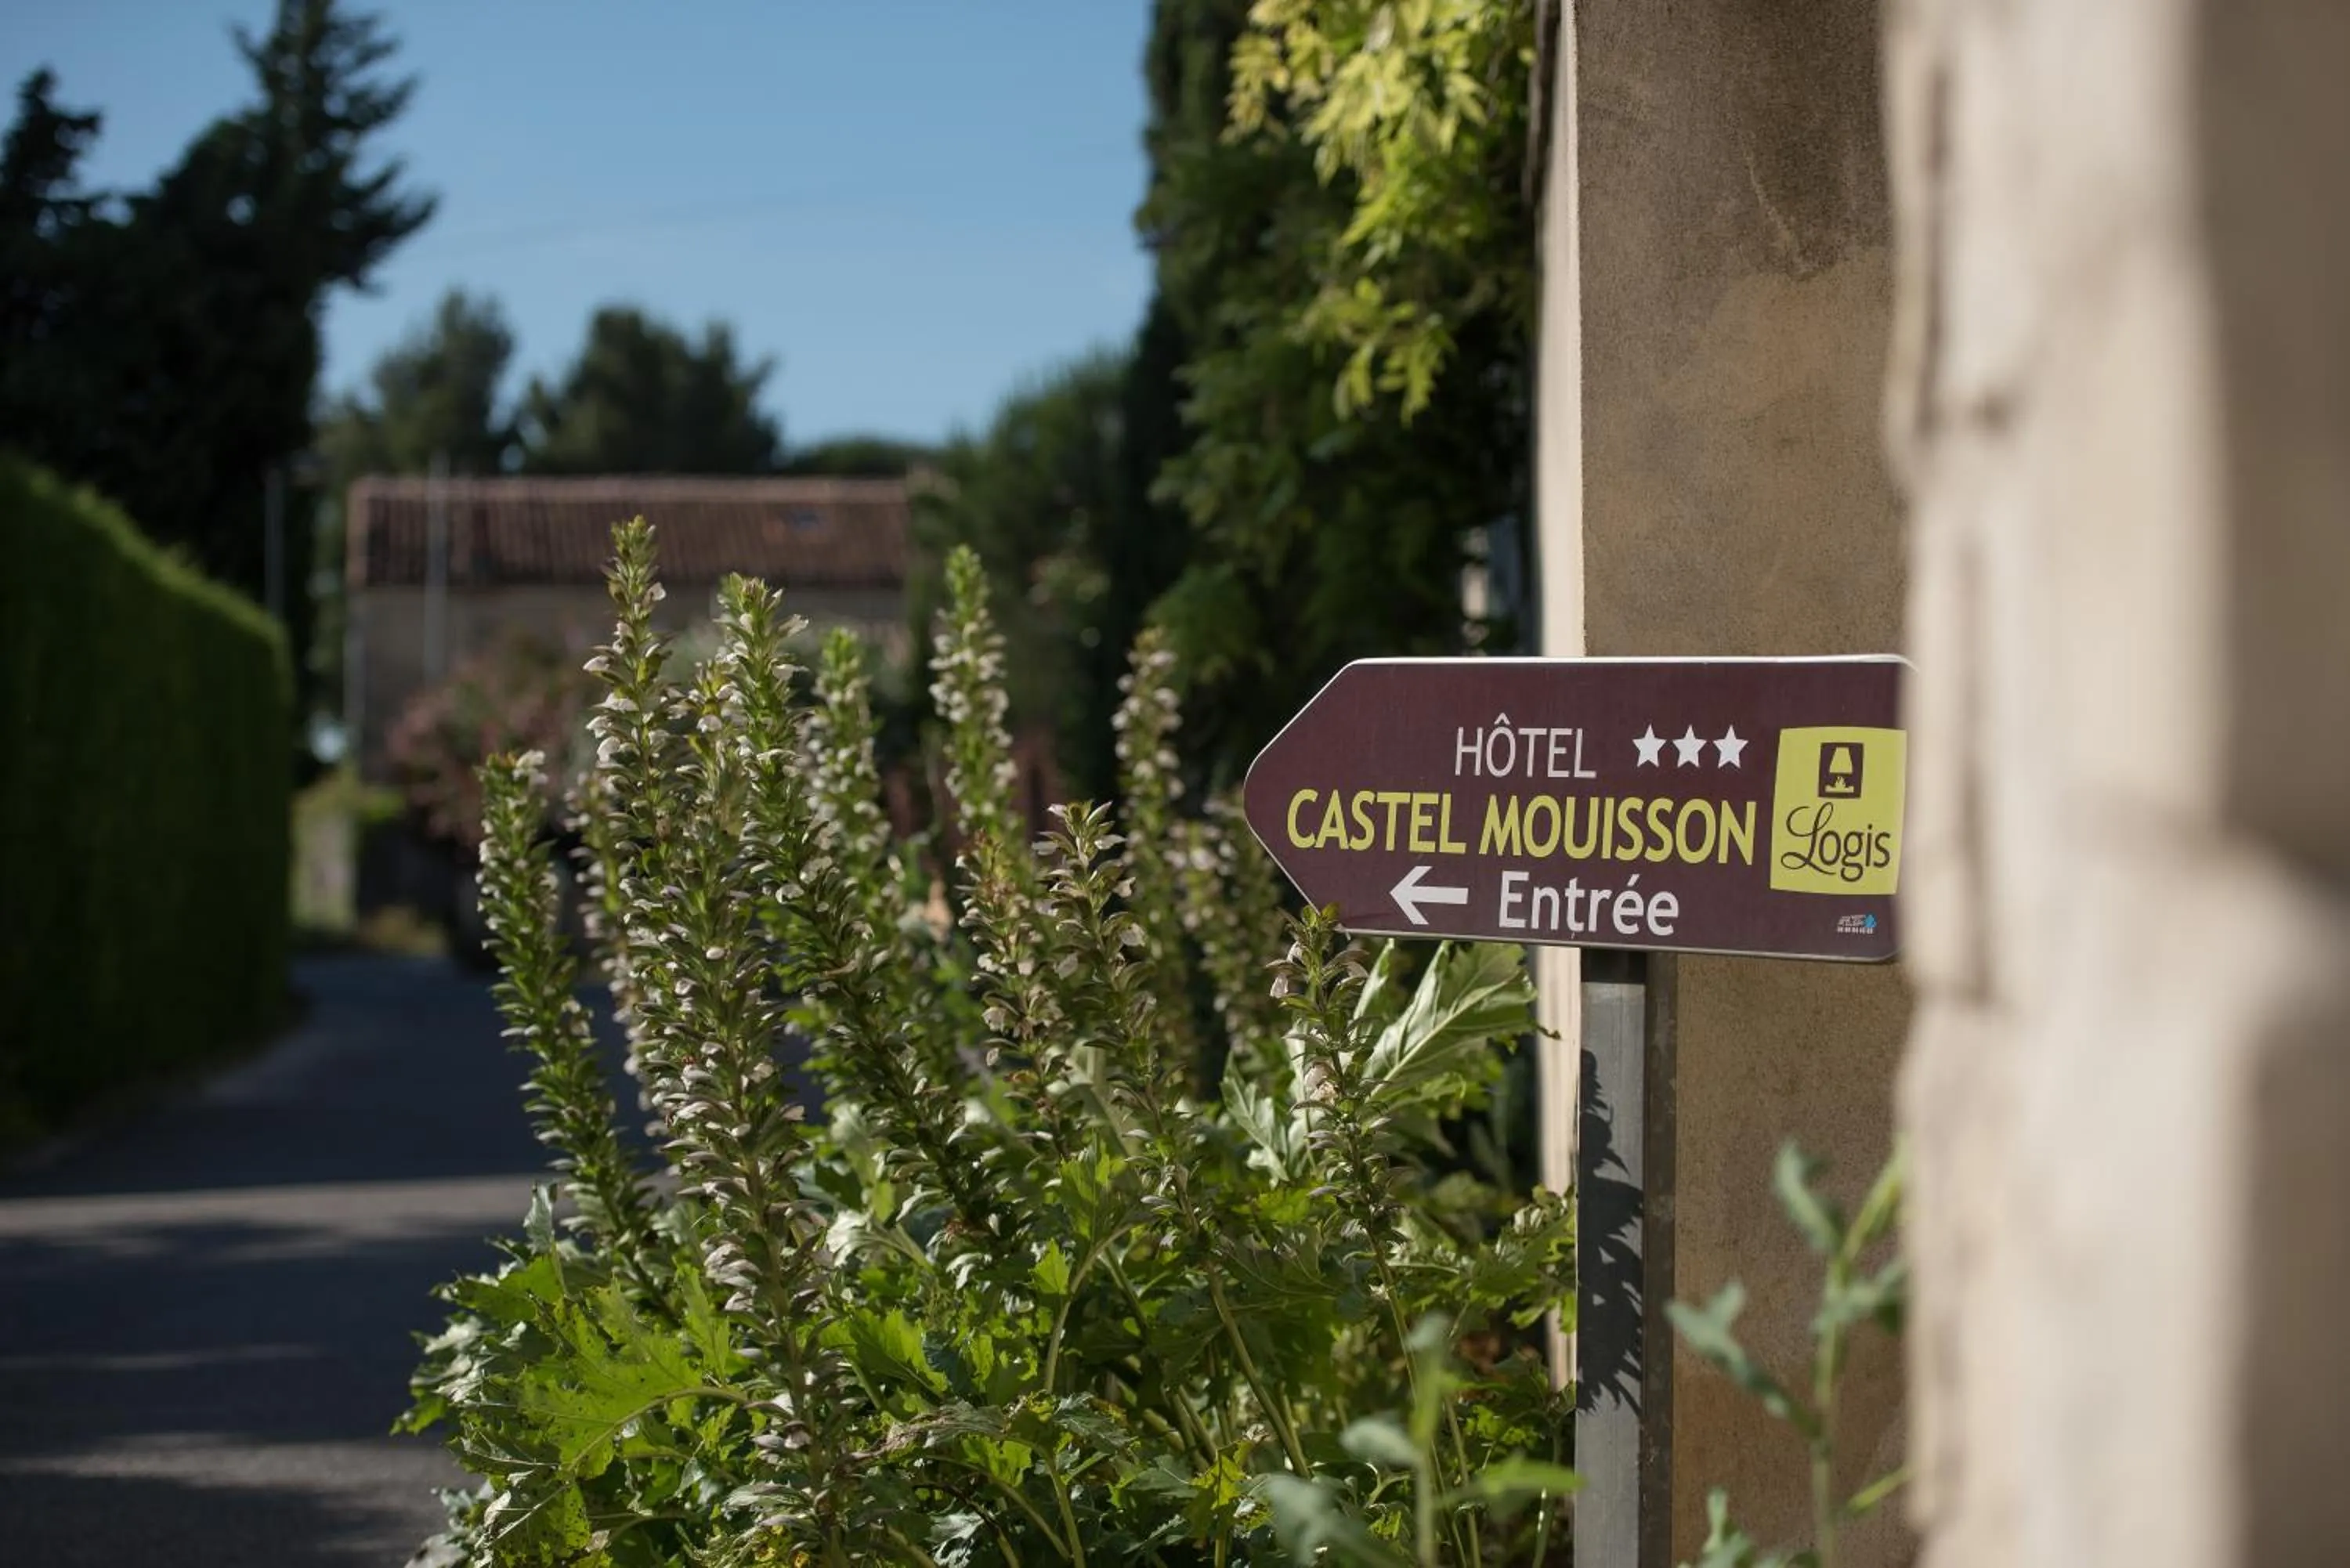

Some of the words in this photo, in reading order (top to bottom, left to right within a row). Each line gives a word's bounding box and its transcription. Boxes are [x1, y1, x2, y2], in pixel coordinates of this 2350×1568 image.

[1455, 712, 1596, 780] HÔTEL
[1287, 789, 1467, 855] CASTEL
[1479, 794, 1757, 866] MOUISSON
[1781, 801, 1891, 882] Logis
[1499, 870, 1679, 937] Entrée
